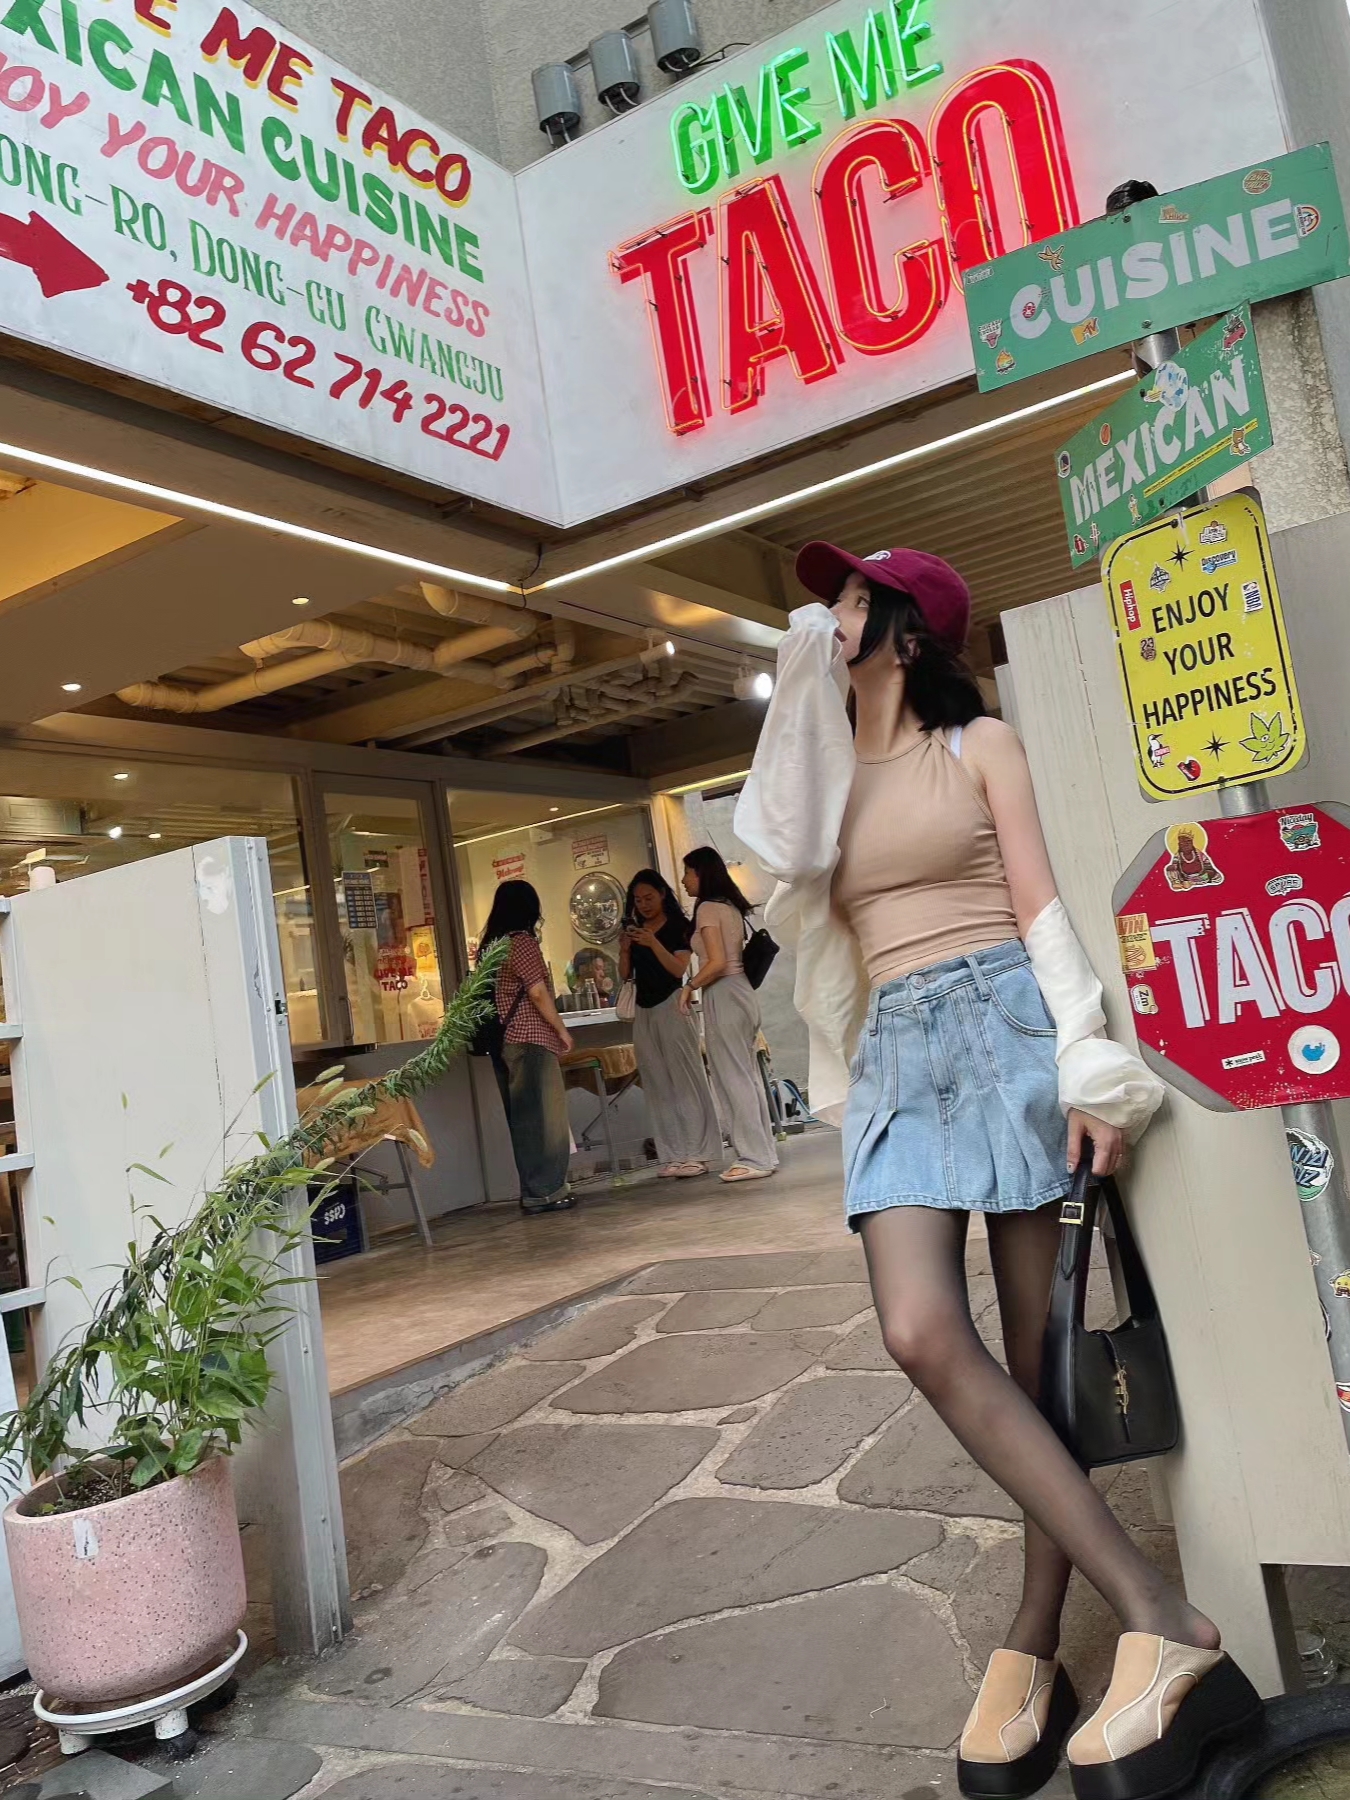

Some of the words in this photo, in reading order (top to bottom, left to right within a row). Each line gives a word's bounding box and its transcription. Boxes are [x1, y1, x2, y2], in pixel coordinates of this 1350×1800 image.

[200, 6, 314, 114] ME
[331, 77, 471, 208] TACO
[669, 47, 823, 195] GIVE
[824, 0, 943, 121] ME
[0, 52, 91, 130] OY
[100, 113, 245, 217] YOUR
[255, 193, 490, 337] HAPPINESS
[261, 117, 485, 283] CUISINE
[607, 58, 1080, 438] TACO
[1009, 198, 1299, 339] CUISINE
[126, 278, 227, 354] +82
[240, 320, 316, 390] 62
[329, 352, 413, 424] 714
[420, 393, 511, 462] 2221
[1069, 356, 1251, 526] MEXICAN
[1124, 587, 1138, 623] Hiphop
[1152, 583, 1230, 633] ENJOY
[1163, 632, 1235, 675] YOUR
[1143, 667, 1277, 730] HAPPINESS
[381, 980, 408, 992] TACO
